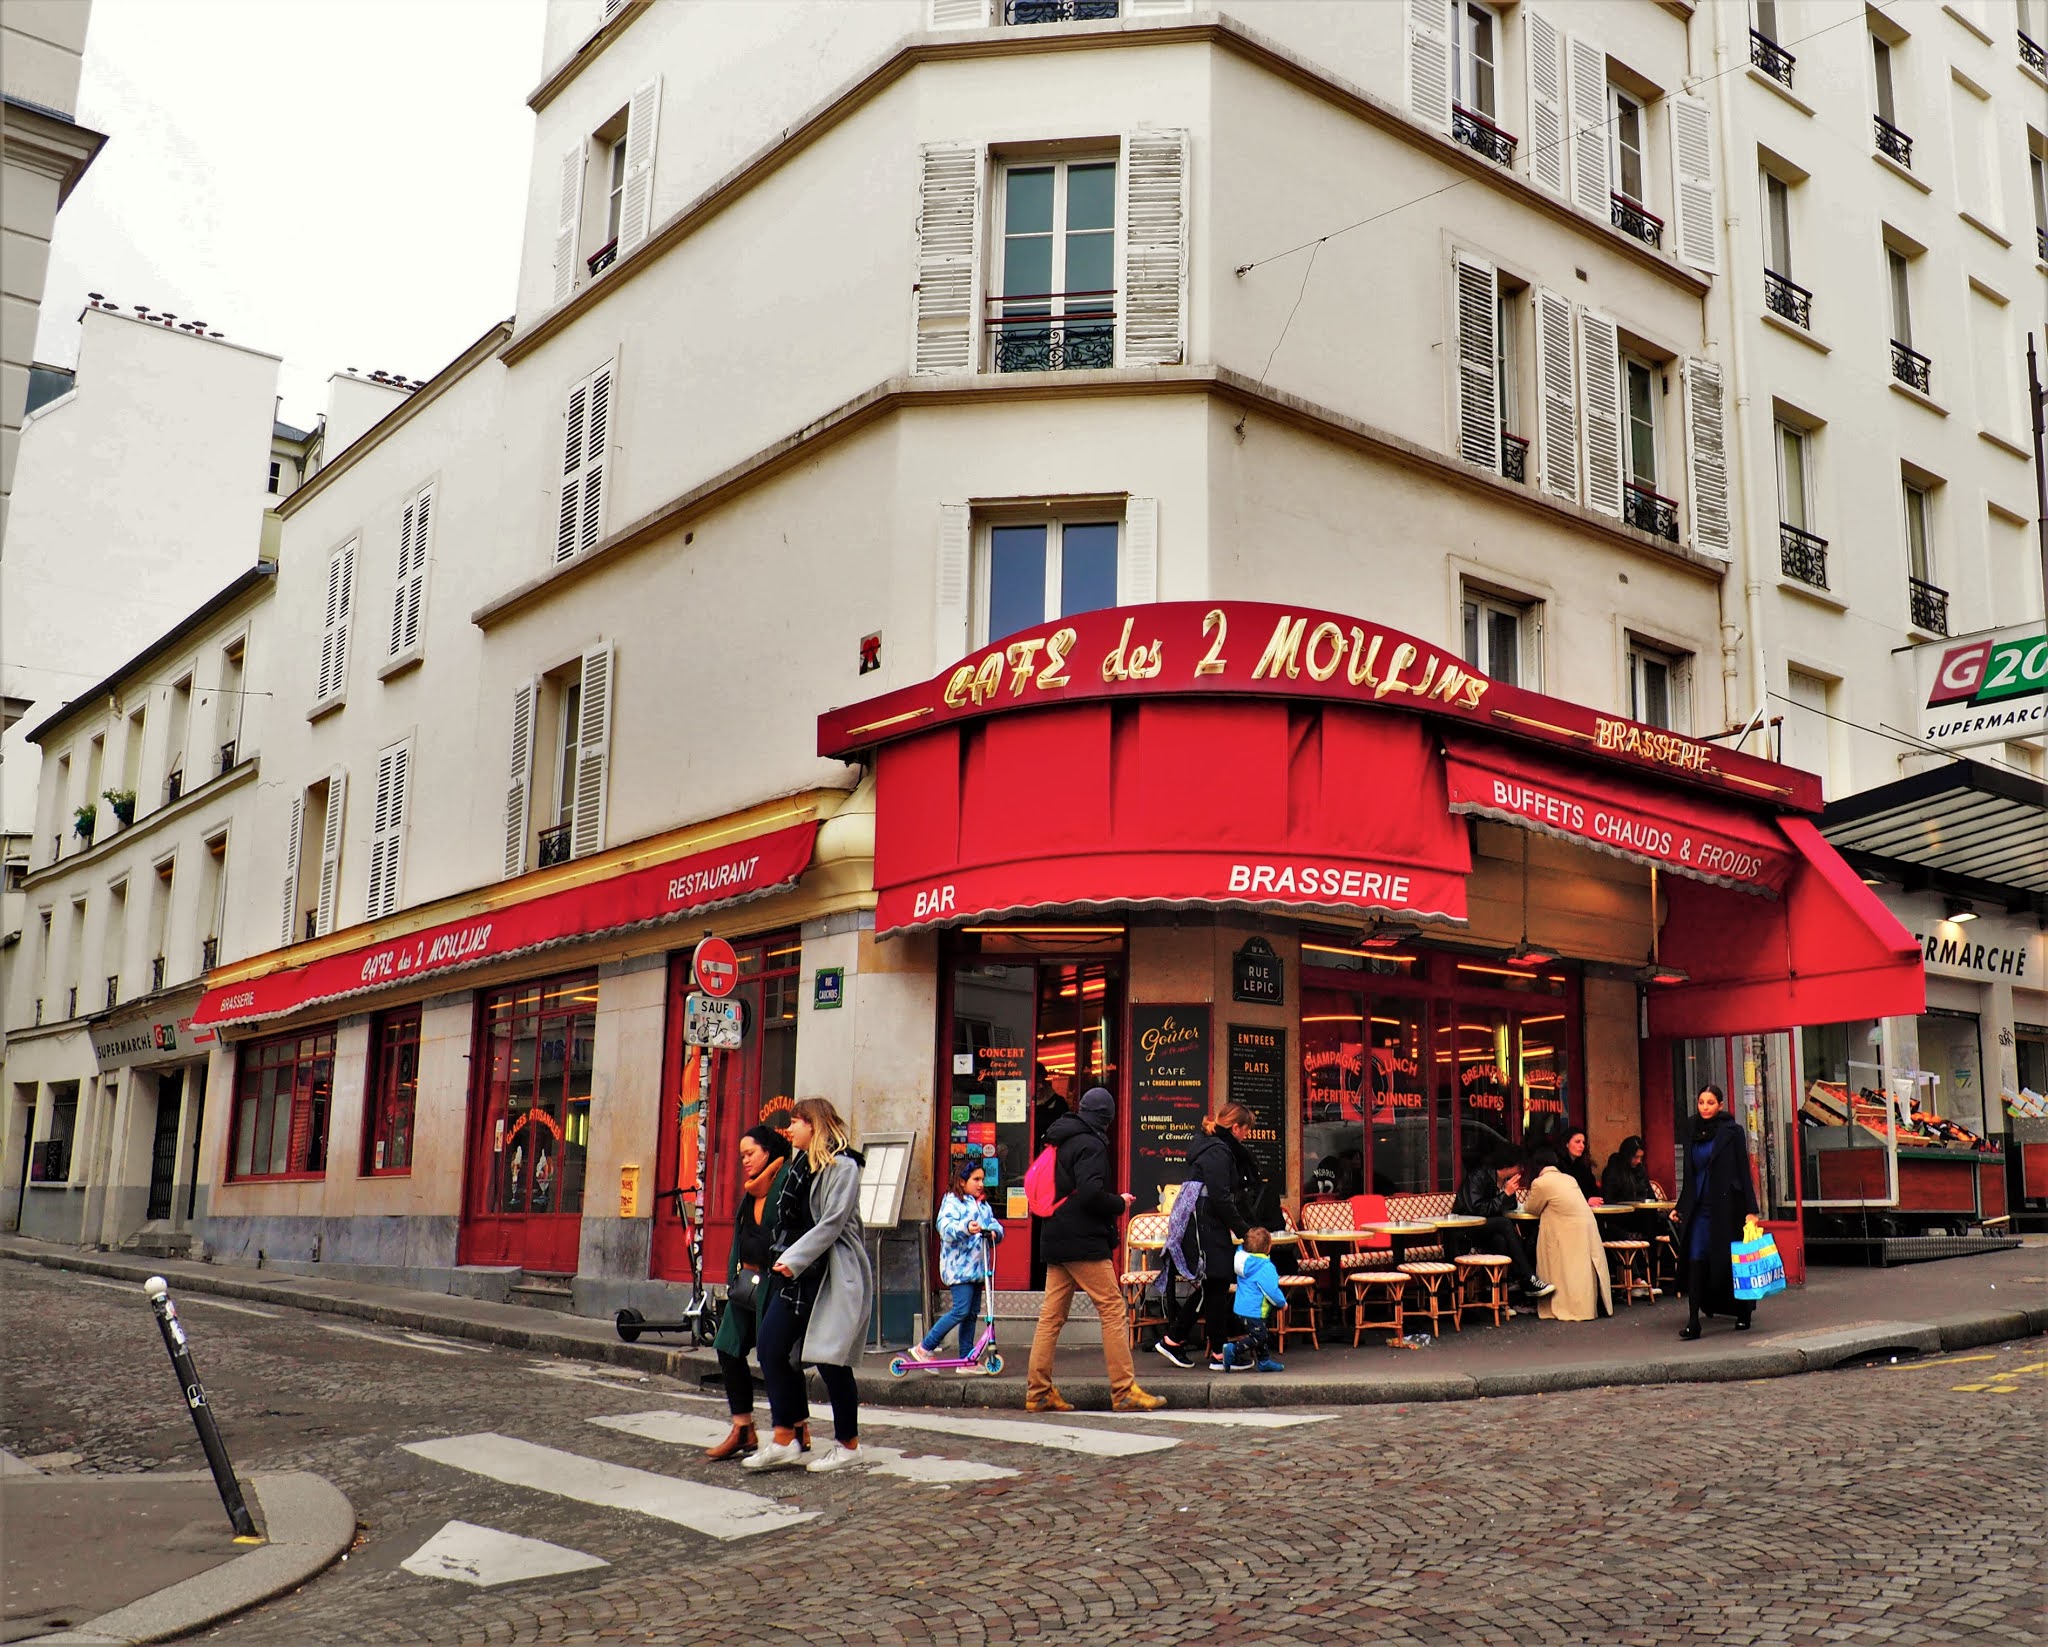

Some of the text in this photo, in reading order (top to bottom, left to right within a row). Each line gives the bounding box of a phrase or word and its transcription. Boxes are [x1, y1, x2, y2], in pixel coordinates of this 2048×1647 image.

[1102, 616, 1163, 682] des
[1194, 608, 1228, 679] 2
[1251, 615, 1490, 711] MOULINS
[1593, 717, 1713, 775] BRASSERIE
[1493, 779, 1762, 878] BUFFETS CHAUDS & FROIDS
[668, 855, 760, 901] RESTAURANT
[1227, 864, 1411, 903] BRASSERIE
[913, 884, 957, 919] BAR
[397, 948, 412, 972] des
[414, 940, 425, 969] 2
[426, 923, 493, 965] MOULINS
[1248, 965, 1270, 979] RUE
[1243, 979, 1274, 994] LEPIC
[220, 991, 255, 1013] BRASSERIE
[701, 1000, 729, 1015] SAUF
[1161, 1015, 1176, 1031] le
[97, 1031, 152, 1060] SUPERMARCHÉ
[1140, 1026, 1200, 1063] Goûter
[1237, 1032, 1275, 1047] ENTREES
[978, 1047, 1026, 1058] CONCERT
[1157, 1065, 1187, 1076] CAFÉ
[1244, 1061, 1270, 1074] PLATS
[1303, 1050, 1362, 1077] CHAMPAGNE
[1376, 1057, 1418, 1077] LUNCH
[1461, 1063, 1511, 1087] BREAKFAST
[1524, 1069, 1564, 1089] SERVICE
[1310, 1086, 1358, 1105] APÉRITIFS
[1377, 1090, 1422, 1108] DINNER
[1523, 1097, 1564, 1113] CONTINU
[506, 1107, 562, 1145] GLACES ATISANALES
[1244, 1128, 1277, 1141] SSERTS
